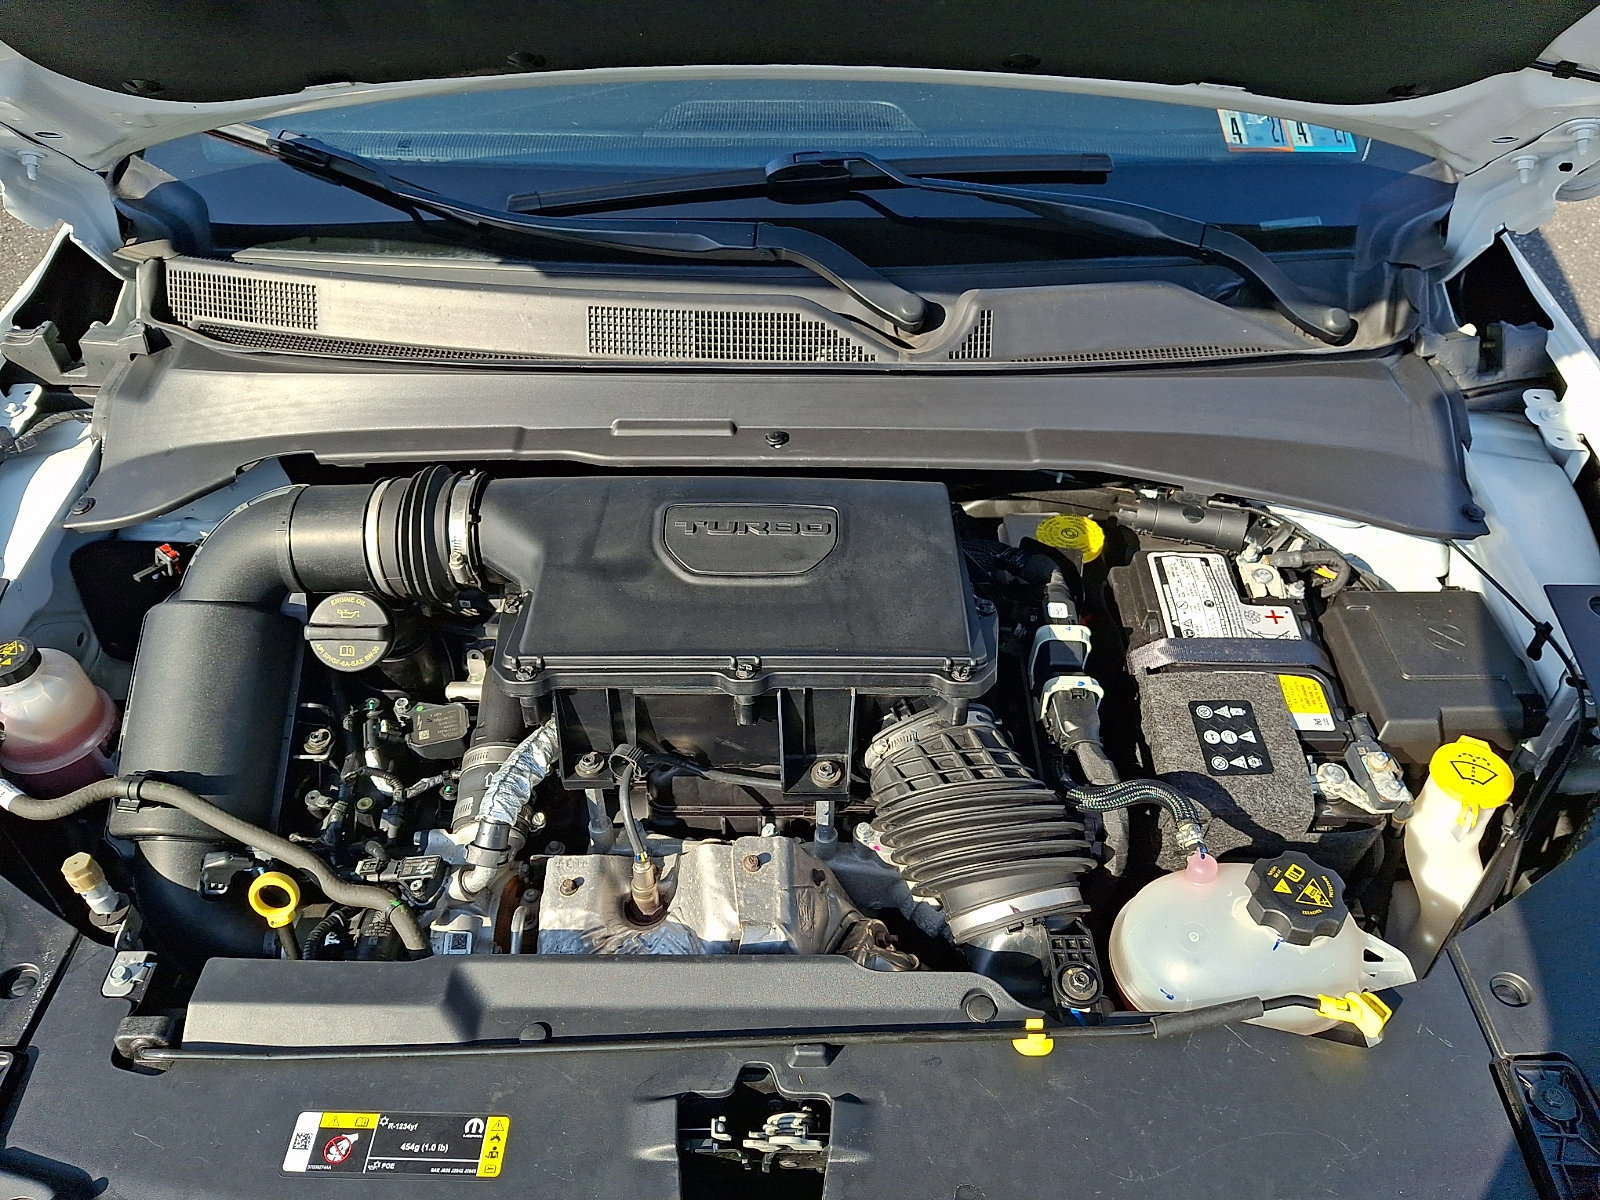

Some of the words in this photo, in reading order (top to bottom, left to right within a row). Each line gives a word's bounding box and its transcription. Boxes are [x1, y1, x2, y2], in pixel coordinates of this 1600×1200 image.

[1230, 117, 1243, 144] 4
[1296, 121, 1308, 144] 4
[674, 520, 832, 536] TURBO
[330, 596, 355, 606] ENGINE
[356, 598, 366, 607] OIL
[387, 1122, 419, 1132] R-1234yf
[400, 1142, 420, 1153] 454g
[421, 1143, 436, 1153] (1.0
[437, 1143, 449, 1153] lb)
